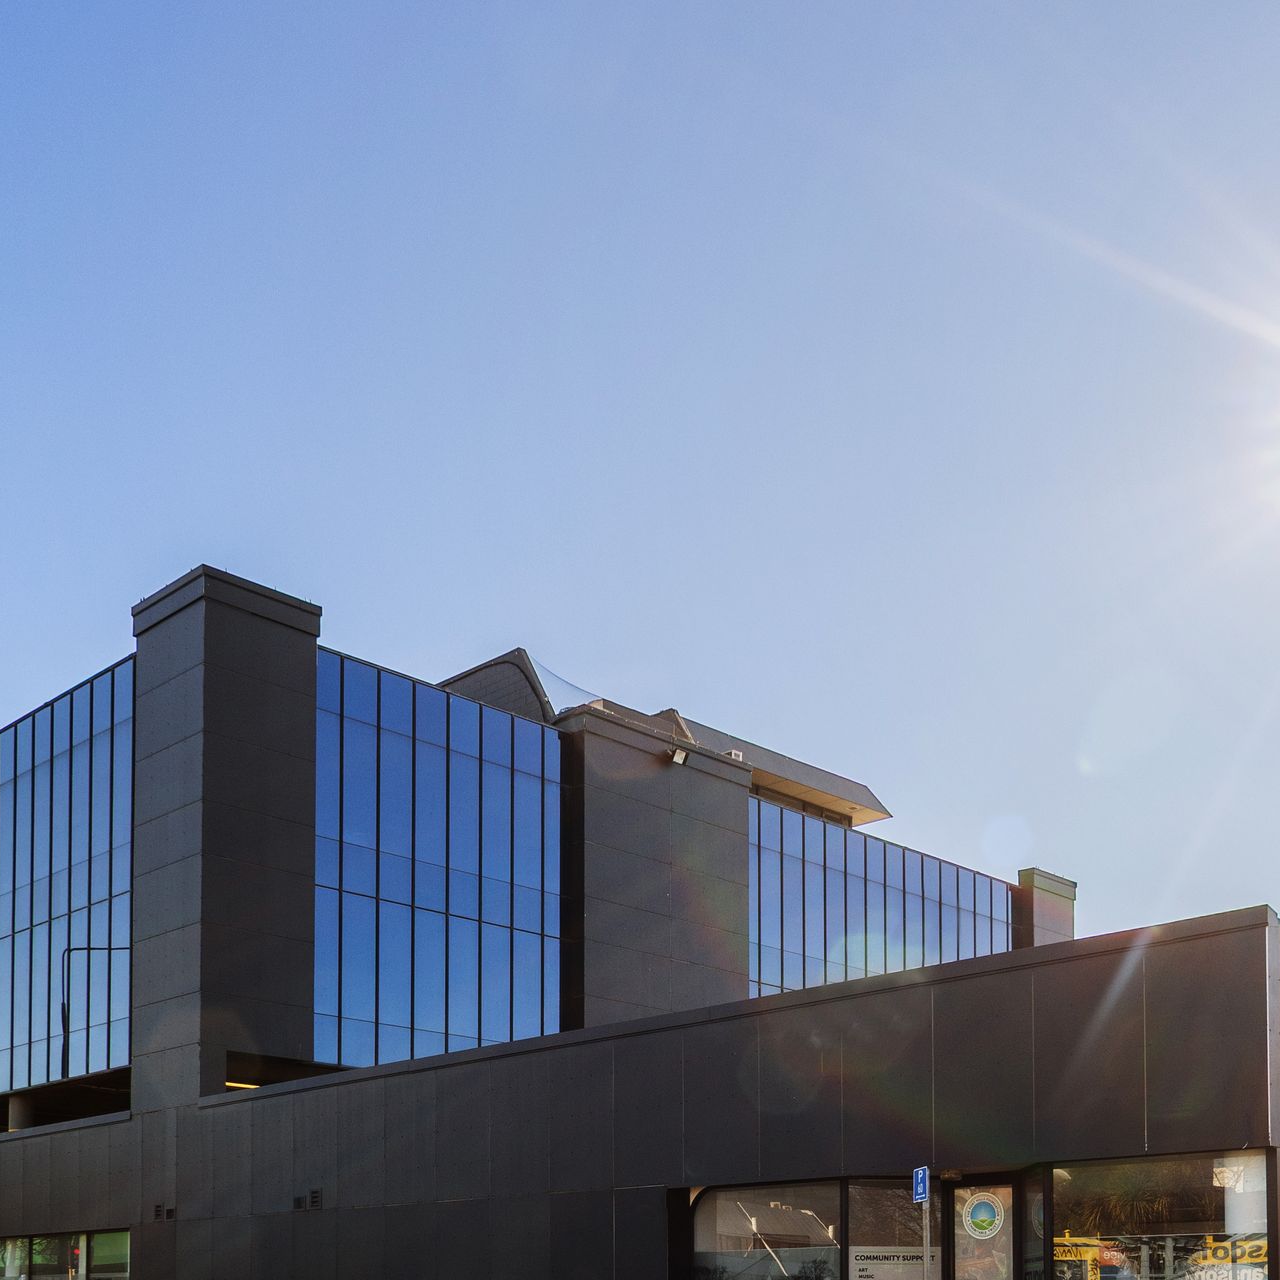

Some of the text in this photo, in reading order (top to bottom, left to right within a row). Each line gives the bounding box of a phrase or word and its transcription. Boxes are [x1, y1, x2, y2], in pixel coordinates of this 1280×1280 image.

[918, 1170, 924, 1183] P
[854, 1254, 936, 1262] COMMUNITY SUPPOT
